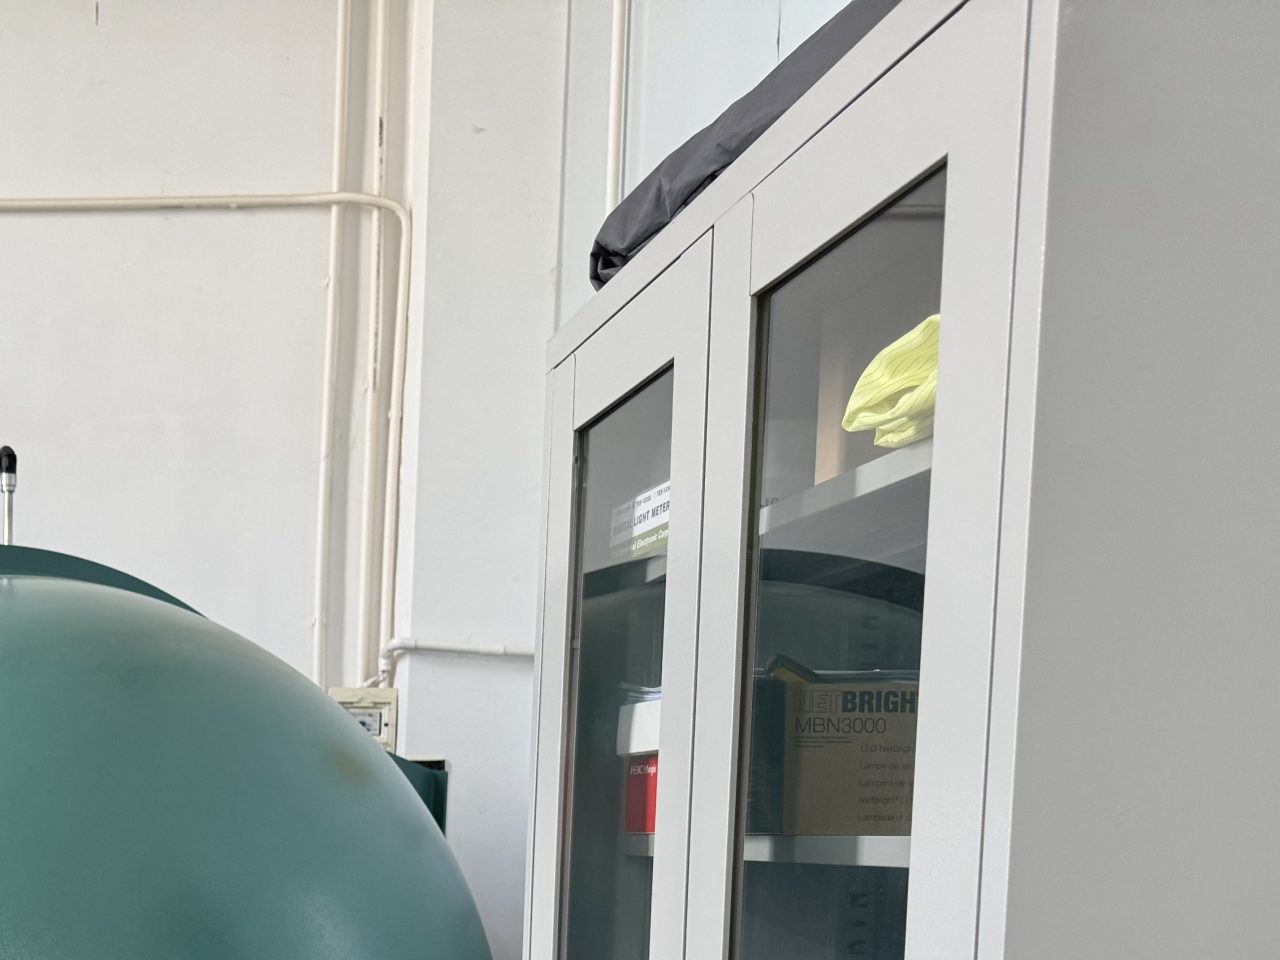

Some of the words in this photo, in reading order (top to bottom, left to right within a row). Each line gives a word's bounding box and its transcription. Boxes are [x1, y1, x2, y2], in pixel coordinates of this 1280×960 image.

[633, 510, 651, 527] LIGHT
[794, 690, 918, 713] NETBRIGH
[795, 717, 887, 733] MBN3000
